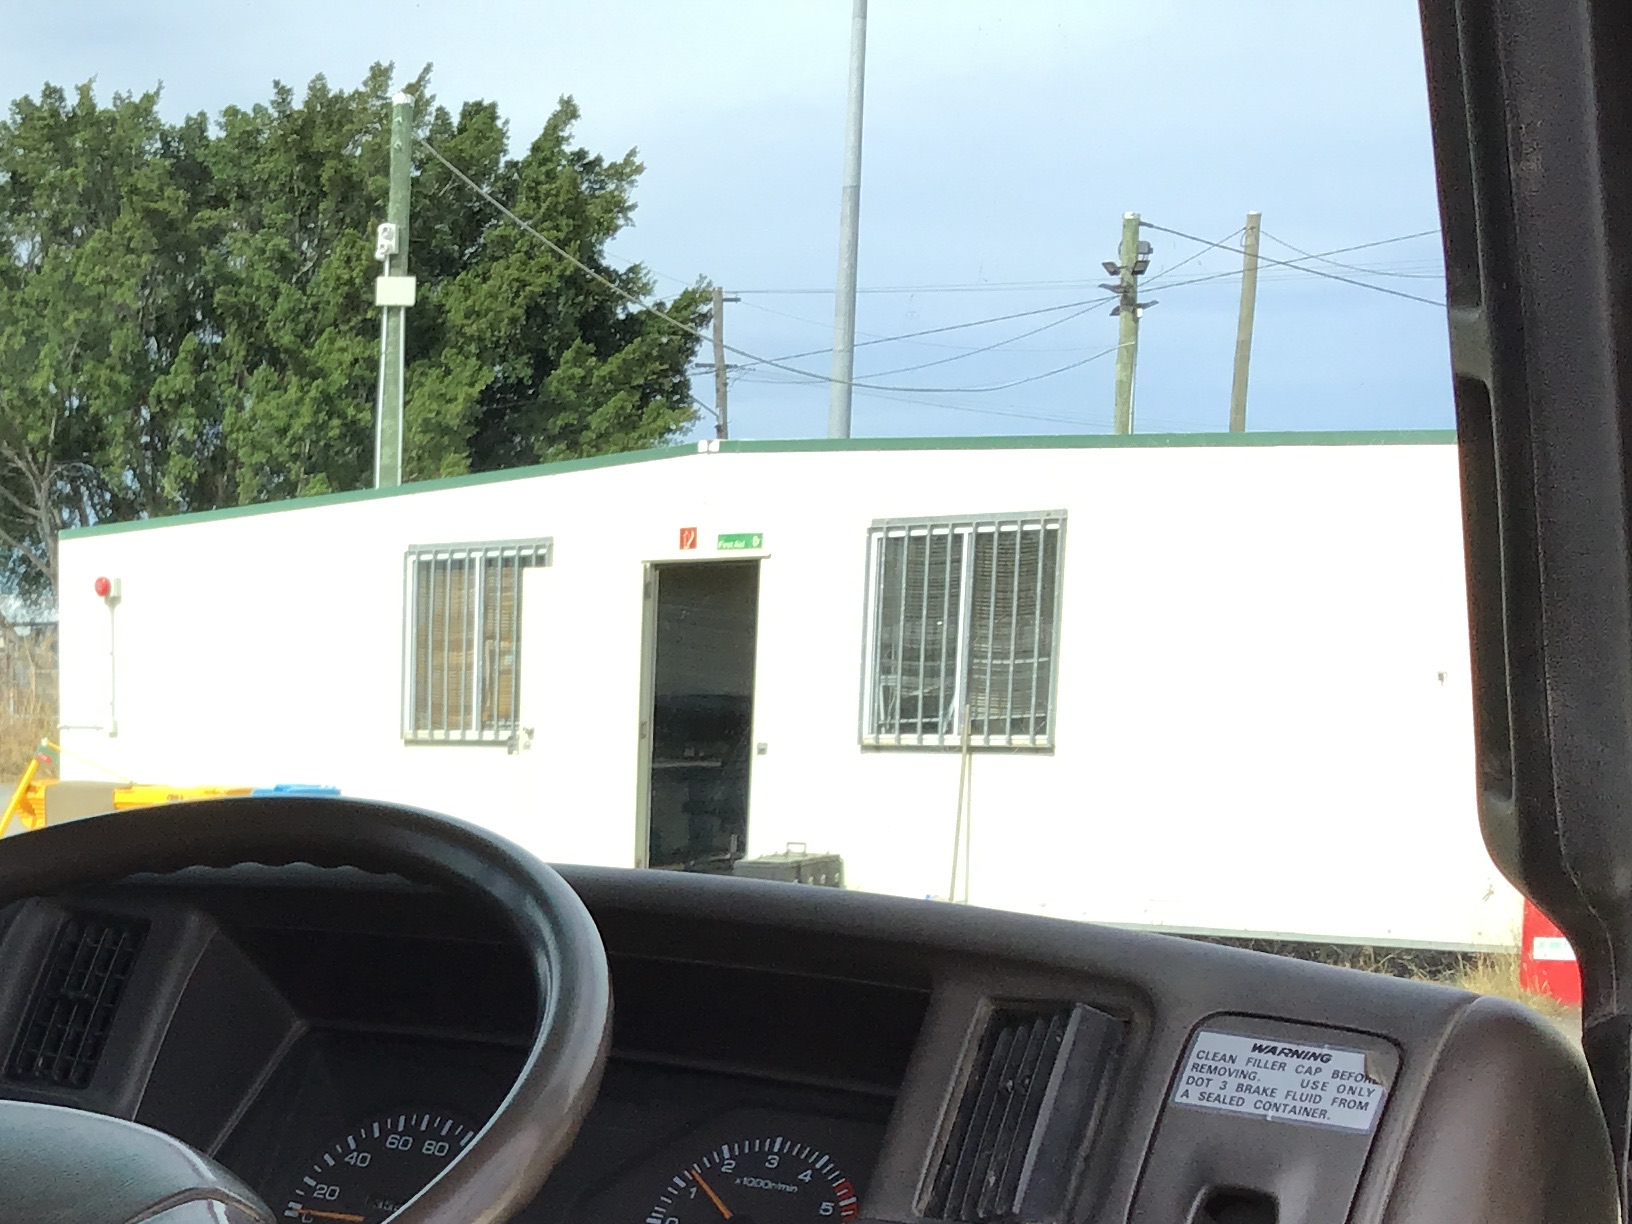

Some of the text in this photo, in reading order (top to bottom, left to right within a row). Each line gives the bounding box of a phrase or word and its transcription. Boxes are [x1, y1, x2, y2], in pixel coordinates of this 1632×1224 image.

[1251, 1042, 1333, 1064] WARNING
[1195, 1050, 1238, 1065] CLEAN
[1245, 1056, 1287, 1073] FILLER
[1295, 1064, 1323, 1077] CAP
[1190, 1062, 1376, 1098] REMOVING. USE ONLY
[1185, 1076, 1370, 1112] DOT 3 BRAKE FLUID FROM
[1180, 1089, 1331, 1121] A SEALED CONTAINER.
[385, 1134, 414, 1150] 60
[421, 1140, 449, 1156] 80
[344, 1152, 371, 1167] 40
[721, 1159, 736, 1173] 2
[765, 1154, 780, 1169] 3
[798, 1169, 812, 1183] 4
[313, 1185, 340, 1200] 20
[819, 1202, 835, 1216] 5
